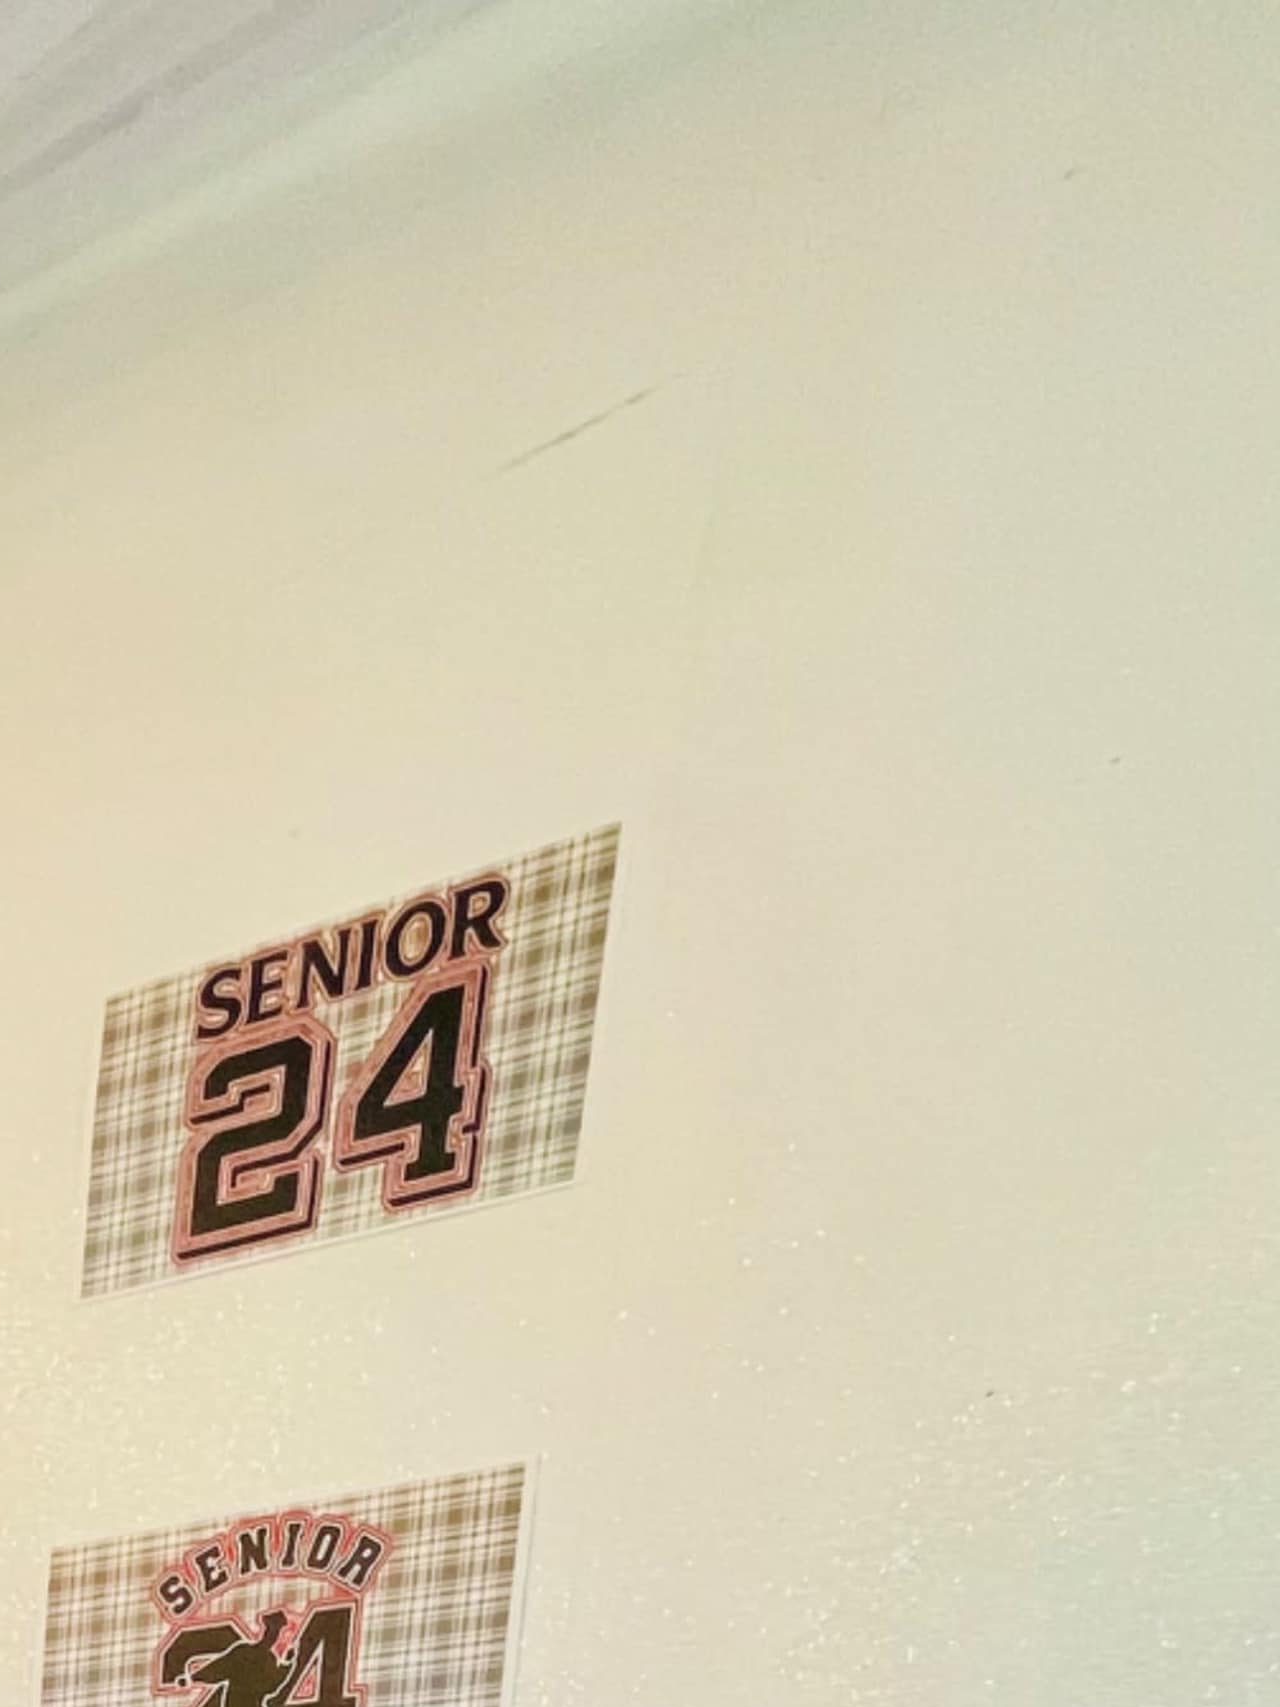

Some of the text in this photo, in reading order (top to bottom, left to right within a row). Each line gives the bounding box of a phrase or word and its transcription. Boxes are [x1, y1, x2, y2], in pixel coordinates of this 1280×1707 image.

[196, 874, 510, 1043] SENIOR
[172, 955, 493, 1266] 24
[154, 1515, 390, 1620] SENIOR
